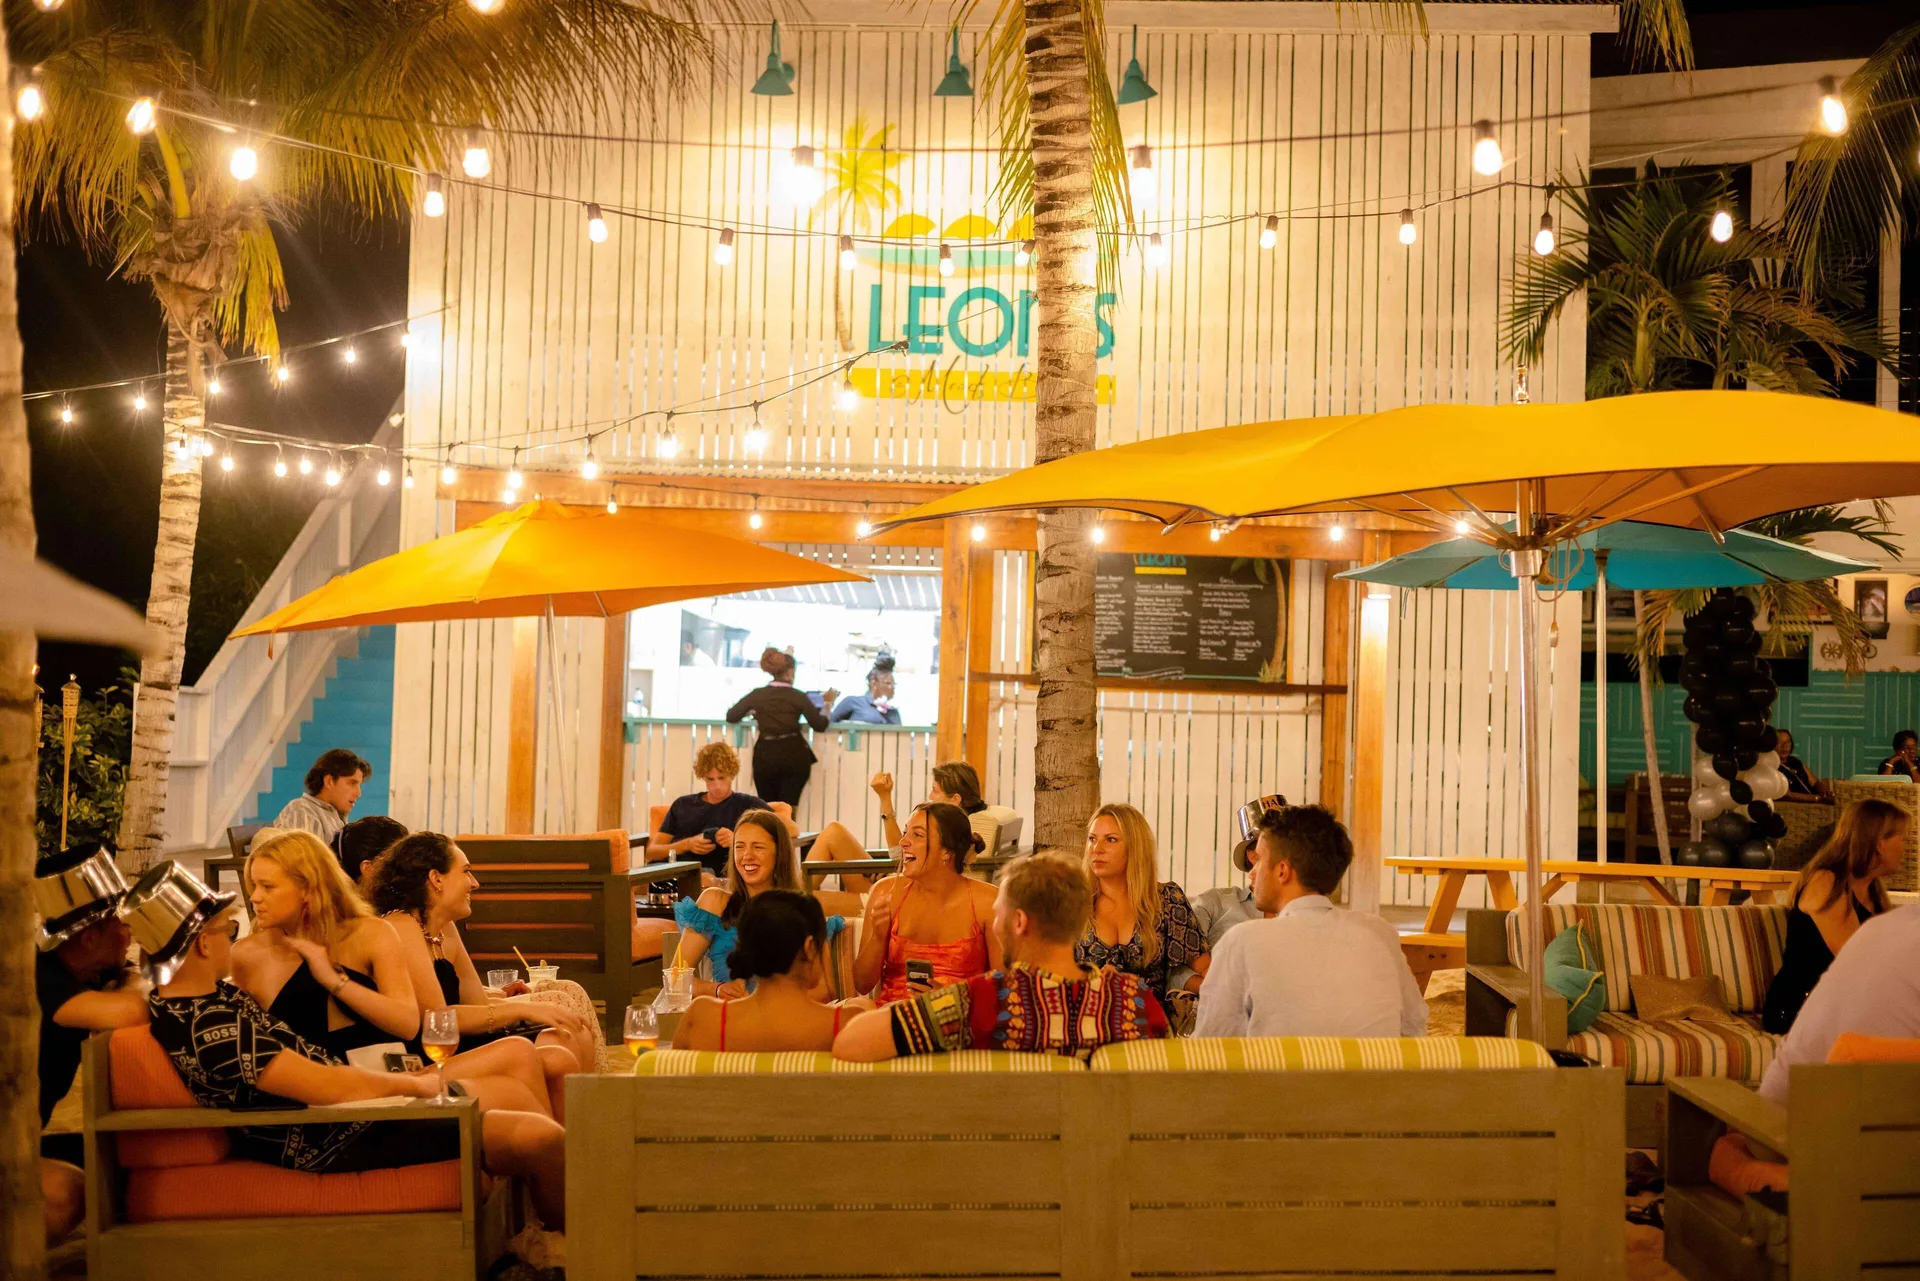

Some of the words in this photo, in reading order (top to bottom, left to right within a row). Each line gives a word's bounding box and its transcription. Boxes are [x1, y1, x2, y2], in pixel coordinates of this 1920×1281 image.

[868, 283, 1117, 358] LEOS
[203, 1027, 238, 1043] BOSS
[241, 1053, 256, 1085] BOSS
